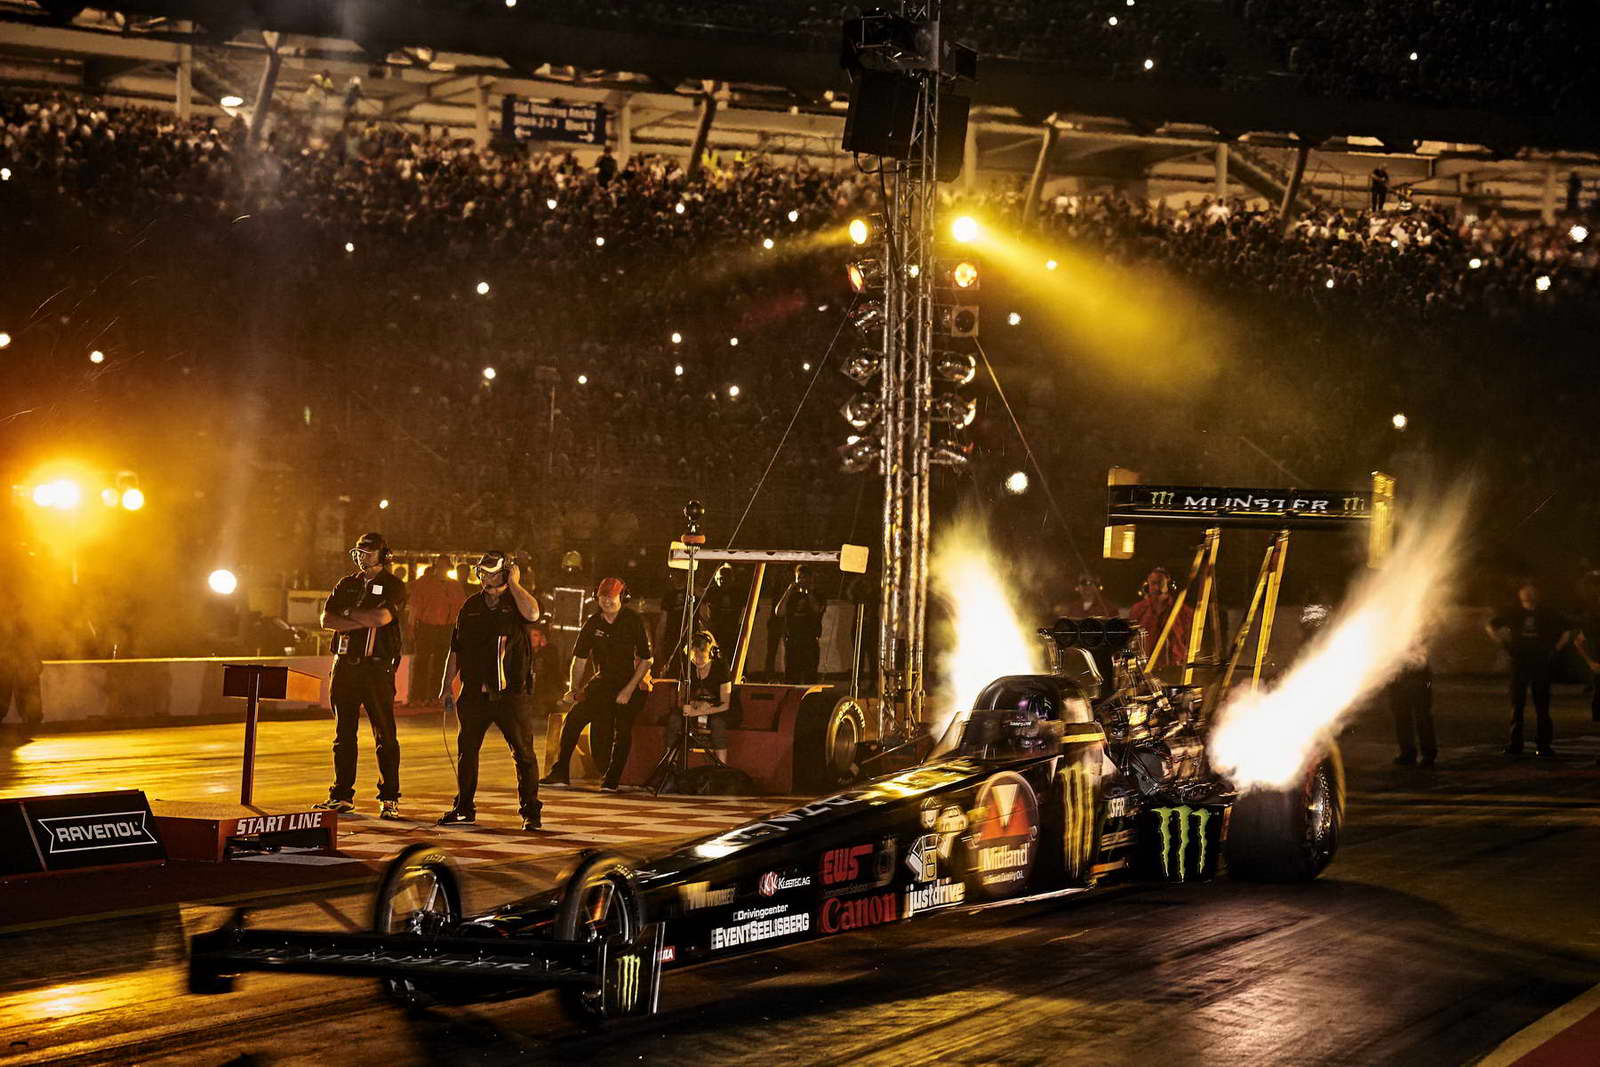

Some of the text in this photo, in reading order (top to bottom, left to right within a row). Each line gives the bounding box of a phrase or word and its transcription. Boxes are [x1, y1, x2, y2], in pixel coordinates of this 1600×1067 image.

[56, 822, 142, 843] RAVENOL
[236, 812, 323, 836] START LINE
[980, 842, 1029, 872] Midland
[903, 878, 966, 919] justdrive
[734, 904, 789, 921] Drivingcenter
[820, 893, 897, 934] Canon
